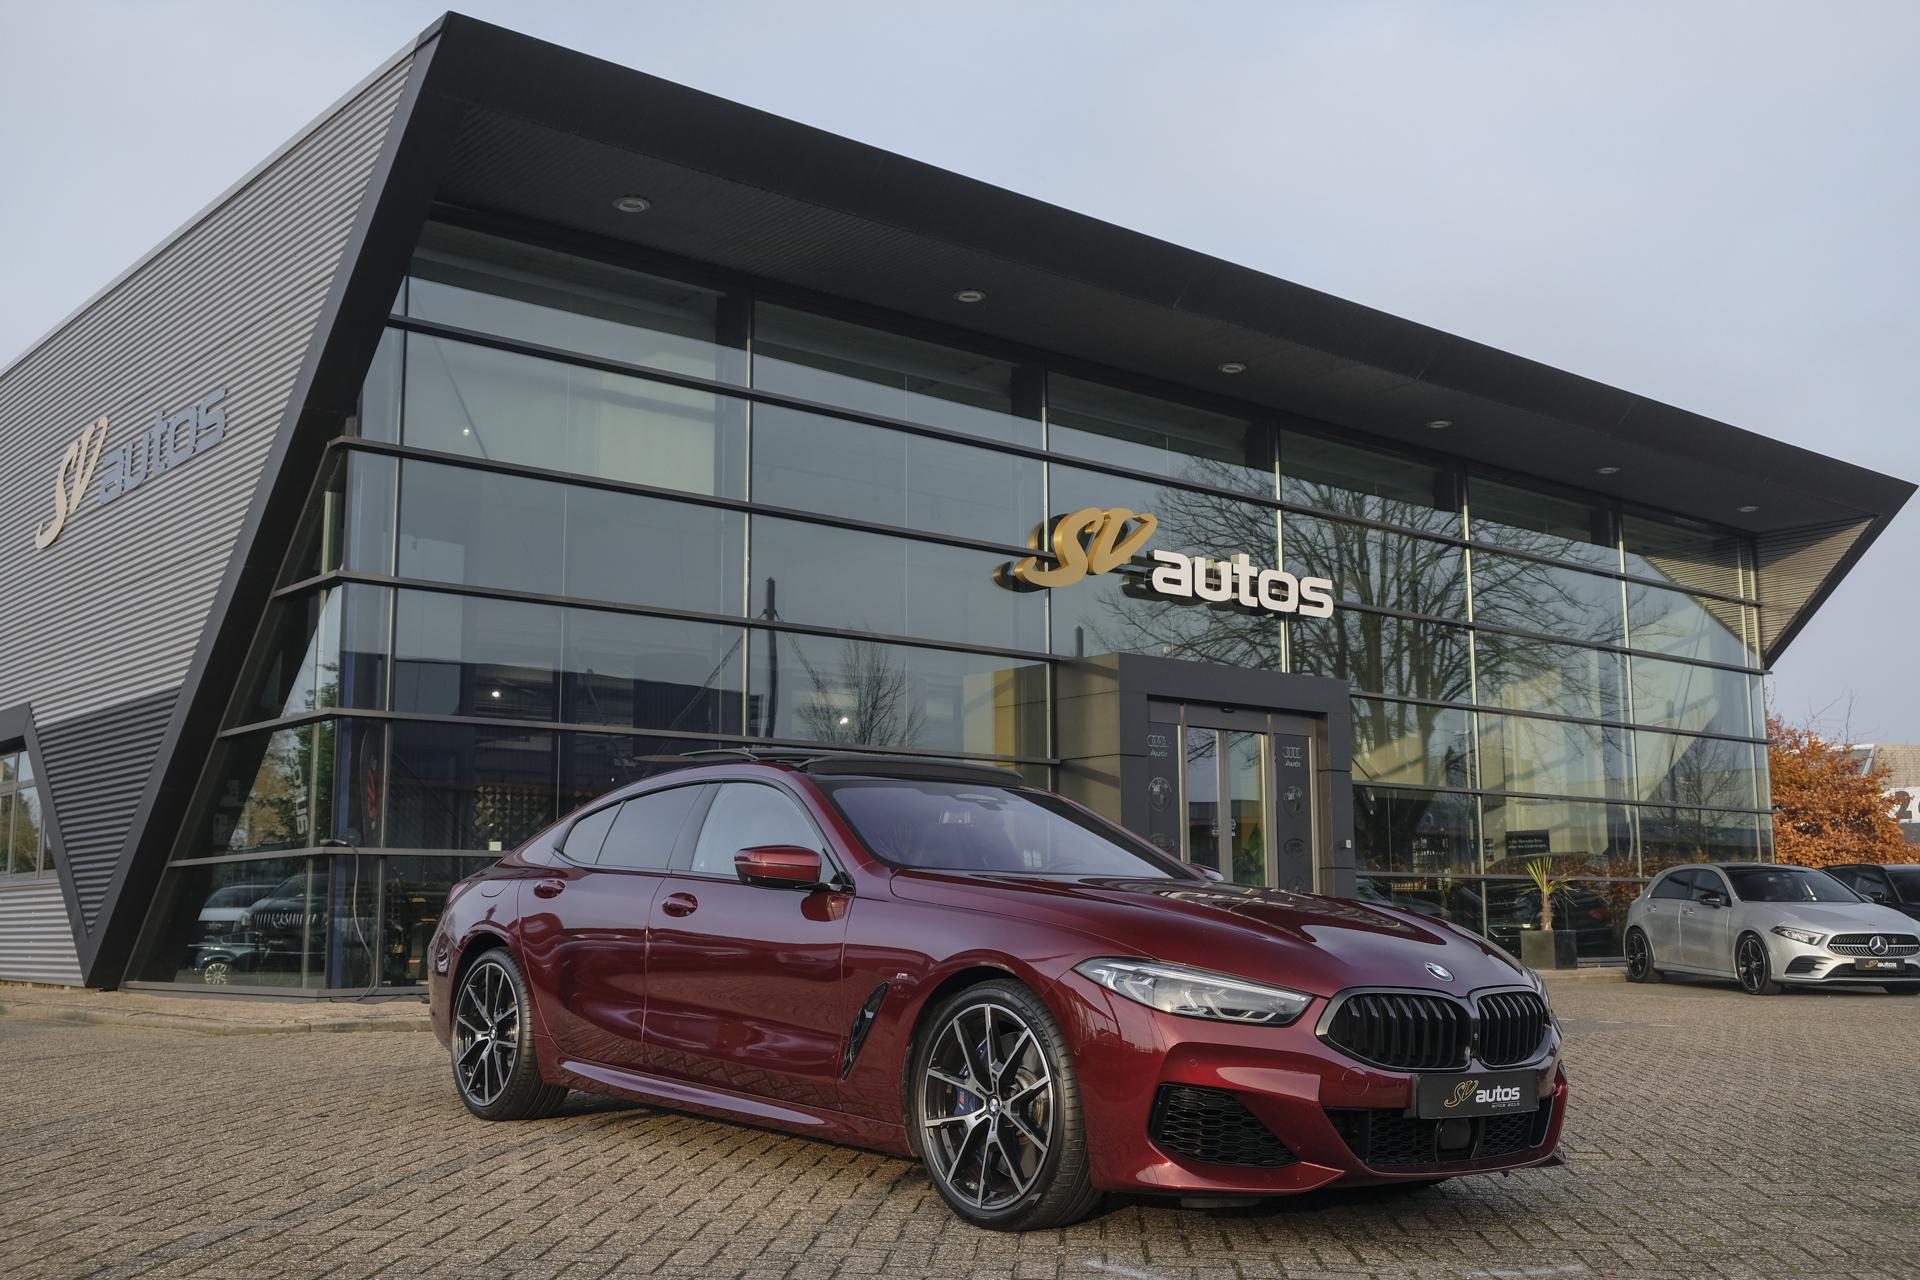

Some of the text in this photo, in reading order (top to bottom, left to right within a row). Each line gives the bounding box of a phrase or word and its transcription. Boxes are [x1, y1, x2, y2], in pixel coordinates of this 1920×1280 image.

[99, 385, 227, 506] autos
[1151, 549, 1334, 619] autos
[1475, 1085, 1520, 1103] autos
